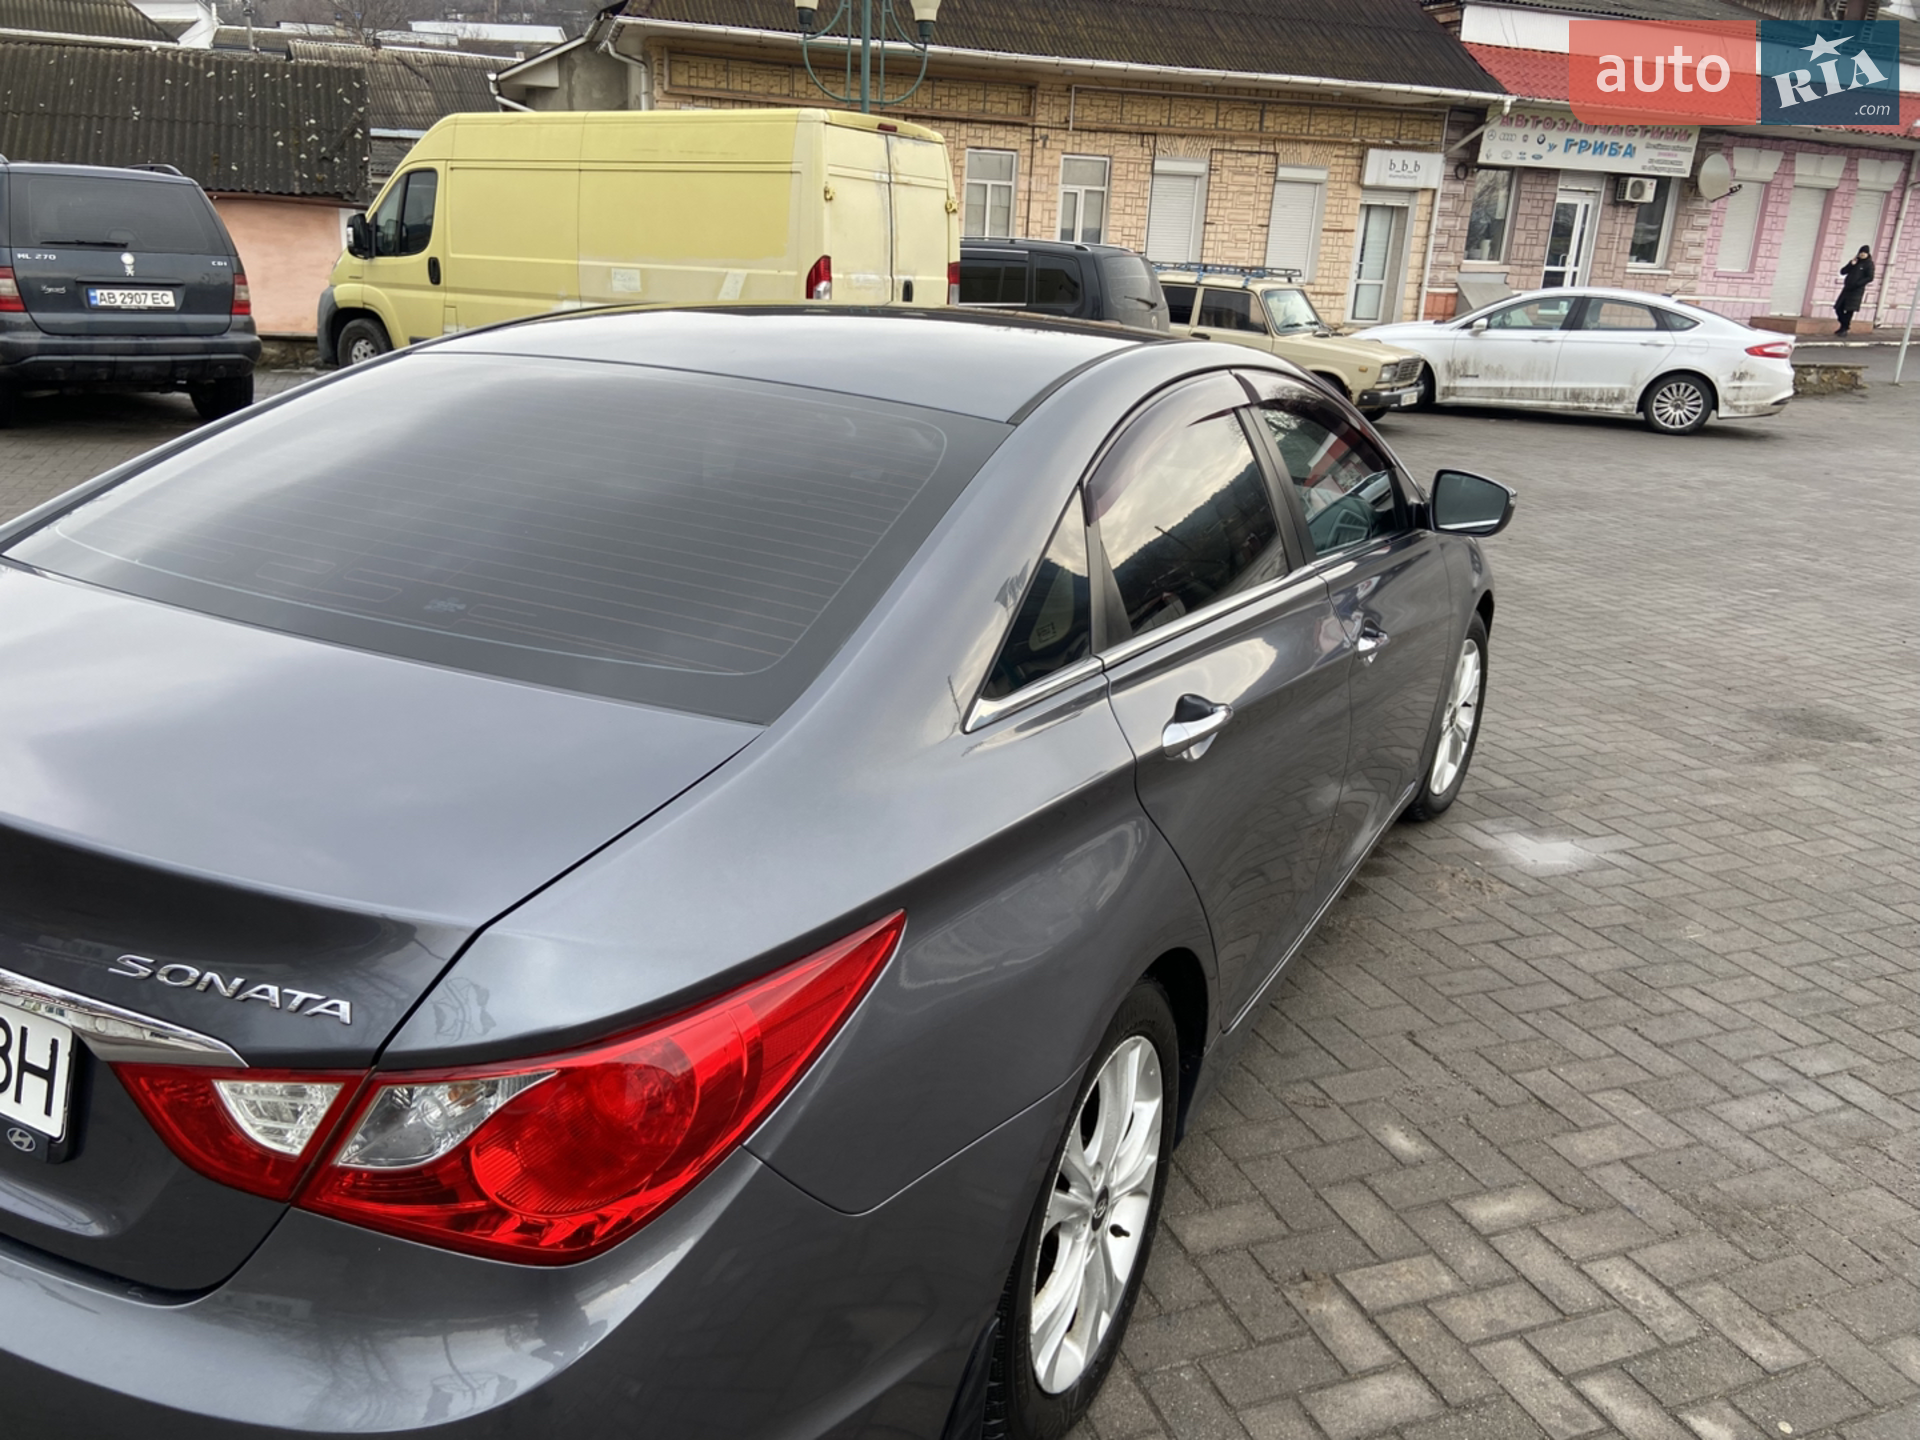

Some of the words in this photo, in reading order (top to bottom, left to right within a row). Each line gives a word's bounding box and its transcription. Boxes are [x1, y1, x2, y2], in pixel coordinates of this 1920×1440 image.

[1499, 114, 1691, 142] АВТОЗАПЧАСТИНИ
[1563, 138, 1635, 158] ГРИБА
[99, 292, 117, 304] AB
[119, 292, 148, 305] 2907
[151, 293, 170, 305] EC
[108, 954, 352, 1025] SONATA
